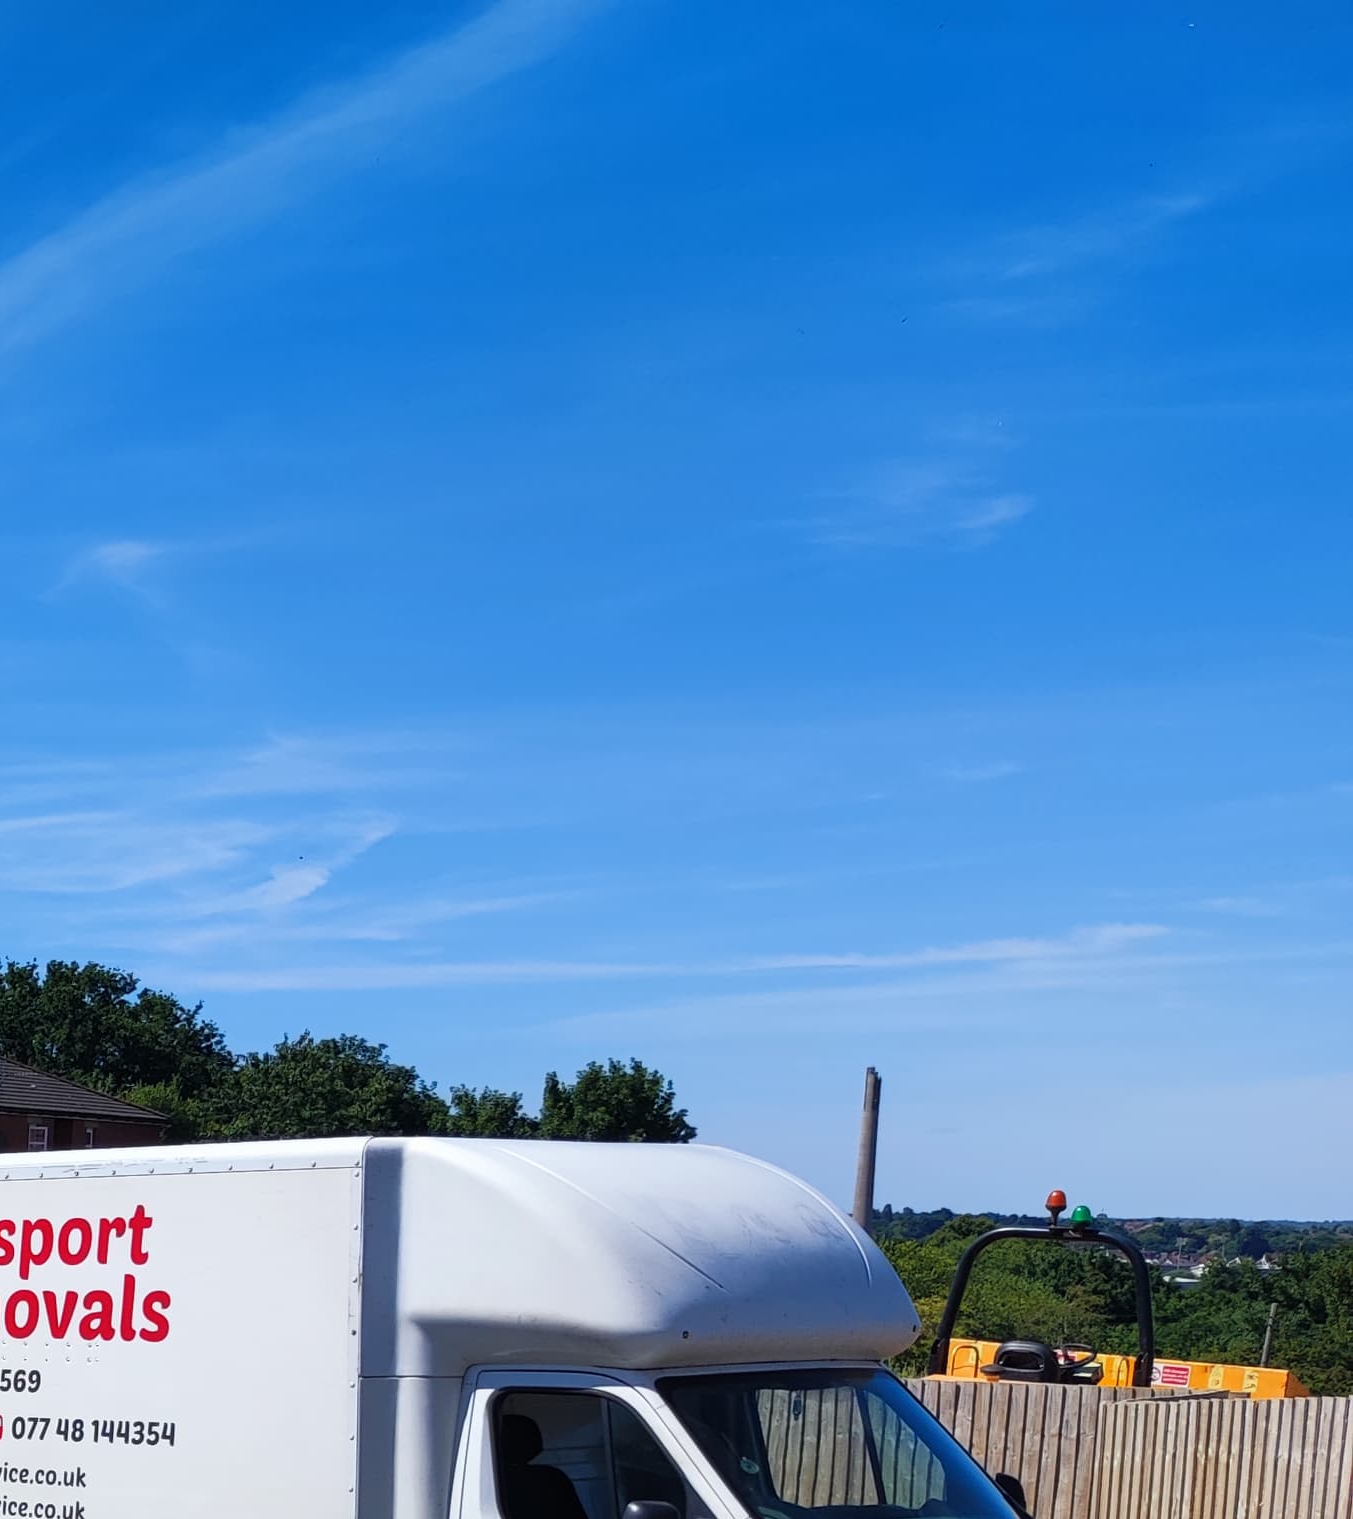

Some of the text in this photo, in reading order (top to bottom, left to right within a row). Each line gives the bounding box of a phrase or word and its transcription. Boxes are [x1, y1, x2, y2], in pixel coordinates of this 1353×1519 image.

[0, 1370, 40, 1393] 569
[12, 1417, 175, 1446] 077 48 144354
